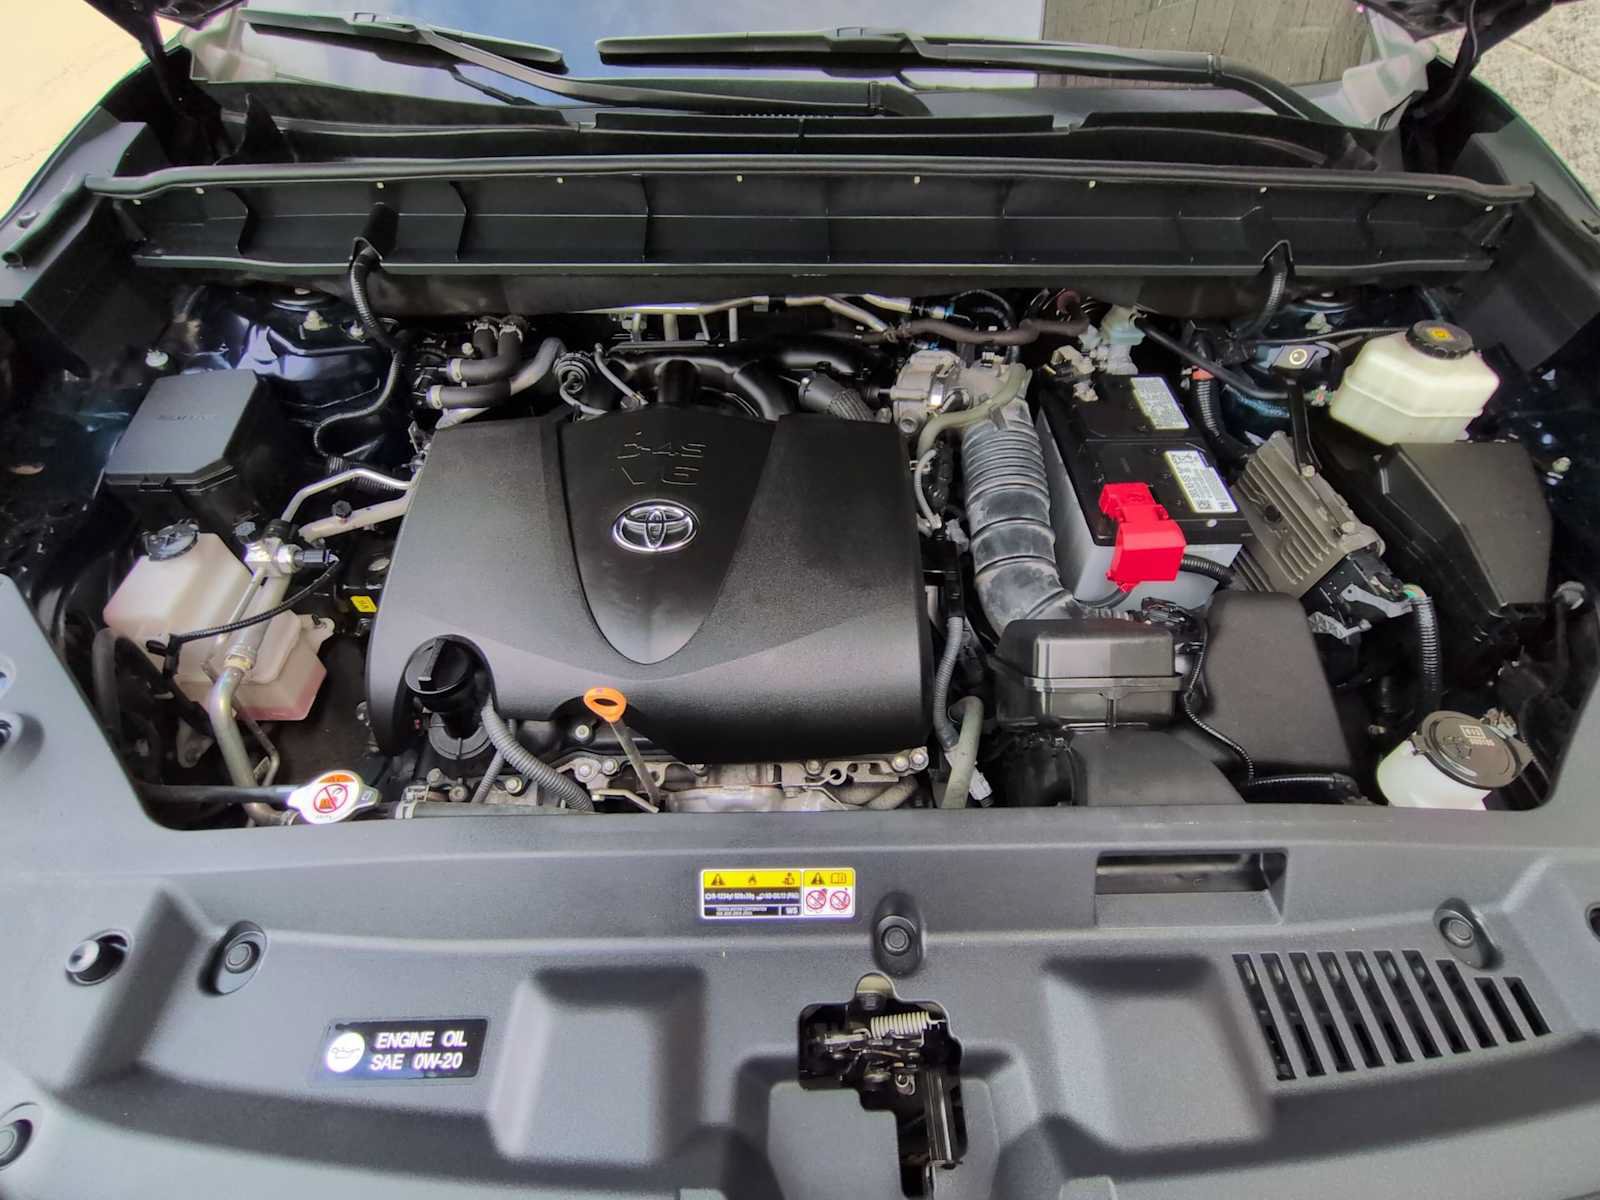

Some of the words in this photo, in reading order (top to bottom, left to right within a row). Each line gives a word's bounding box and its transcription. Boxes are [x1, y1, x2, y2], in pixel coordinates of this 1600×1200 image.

[375, 1031, 435, 1048] ENGINE
[441, 1030, 468, 1047] OIL
[370, 1053, 404, 1070] SAE
[413, 1052, 464, 1070] 0W-20
